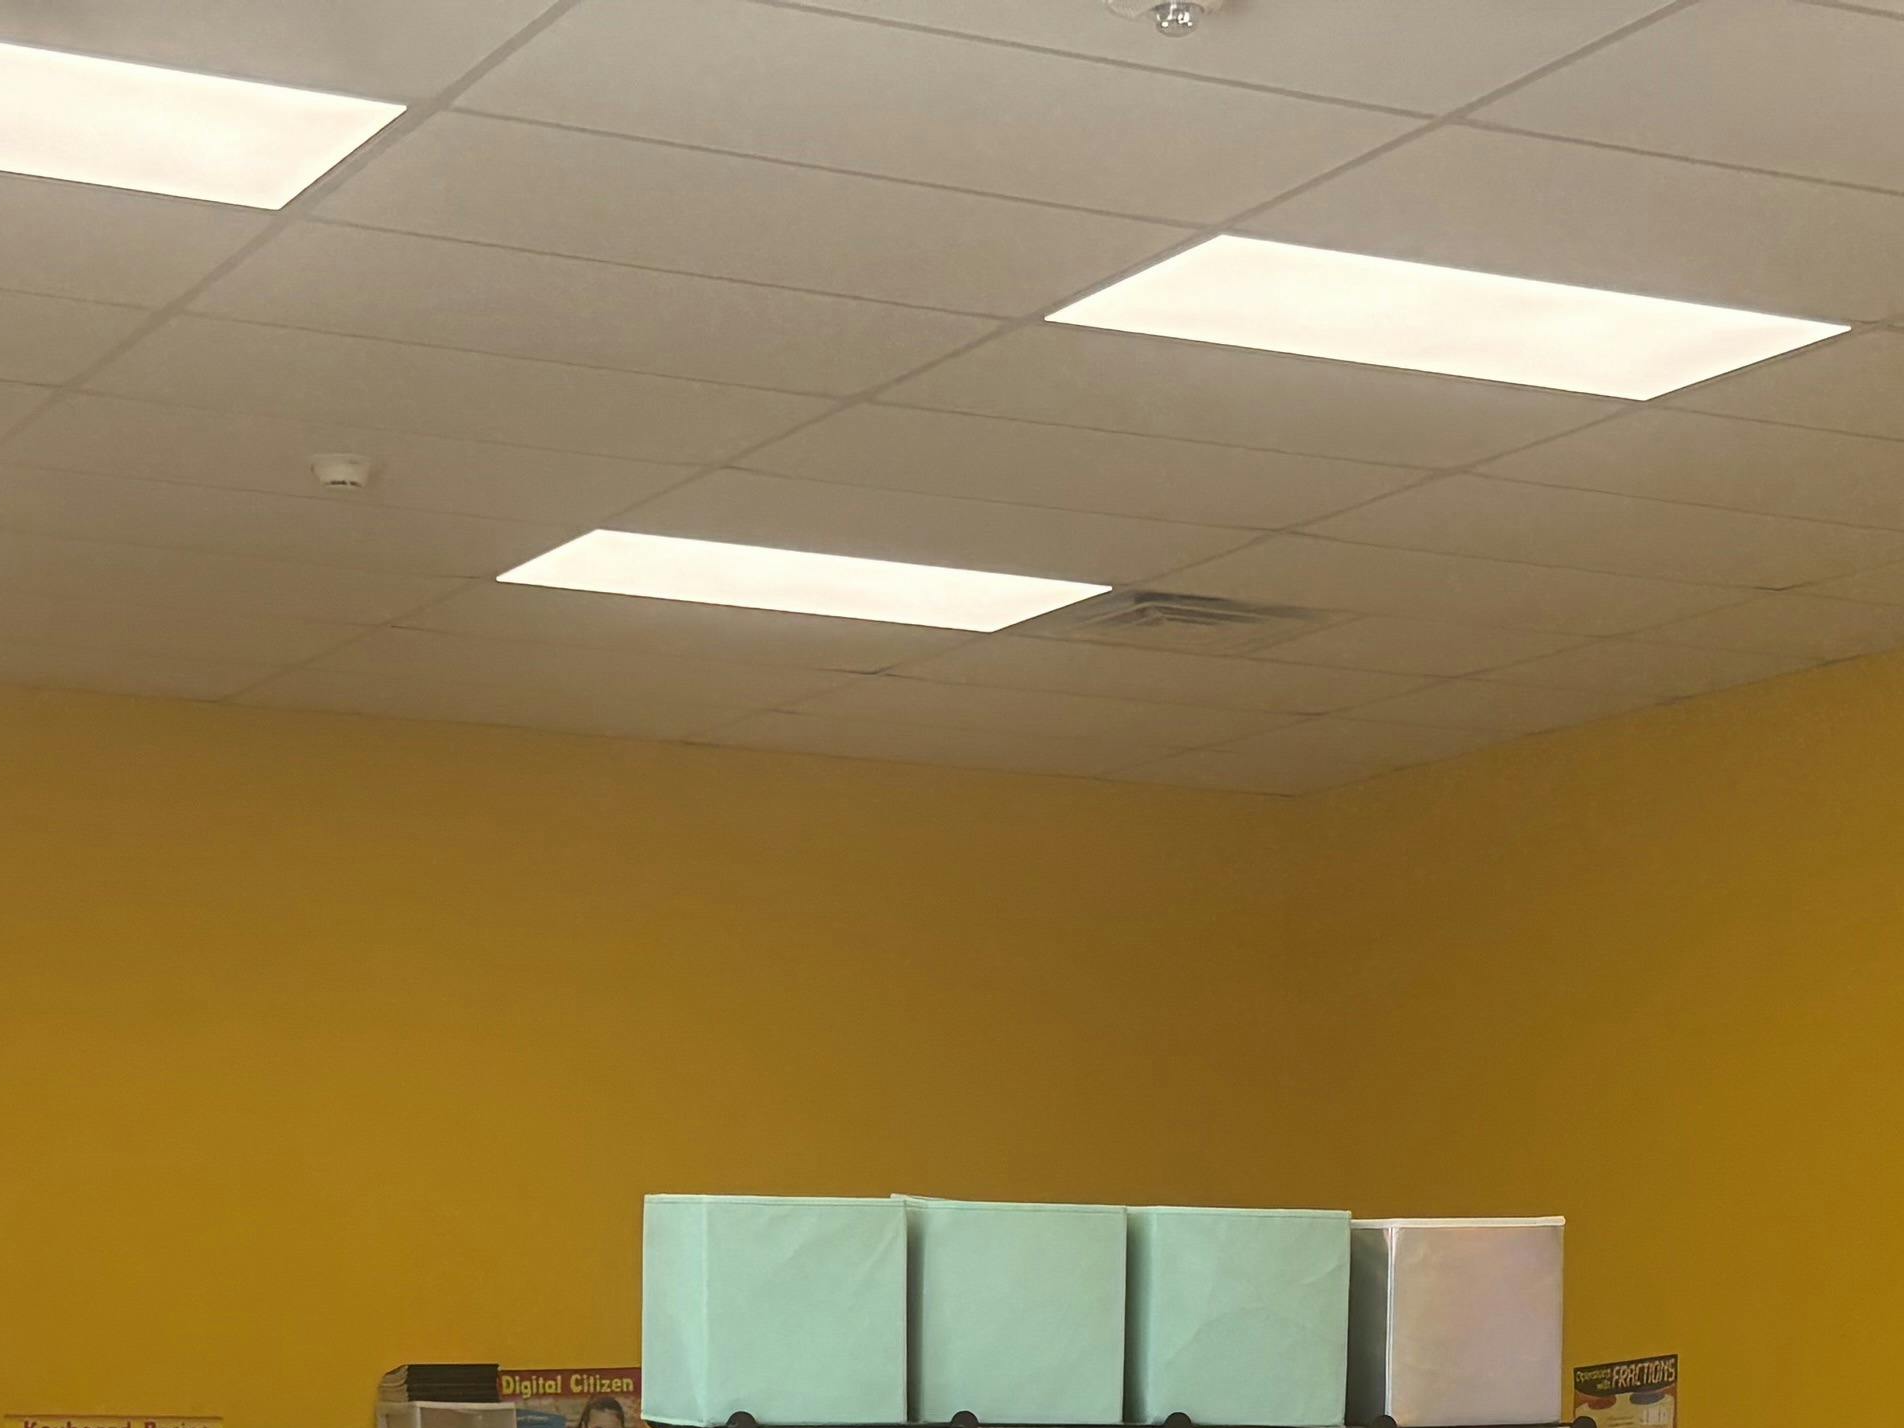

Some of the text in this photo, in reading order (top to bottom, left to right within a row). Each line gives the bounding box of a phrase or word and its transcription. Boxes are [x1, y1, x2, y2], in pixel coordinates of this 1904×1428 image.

[501, 1373, 634, 1399] Digital Citizen
[1612, 1359, 1677, 1388] FRACTIONS
